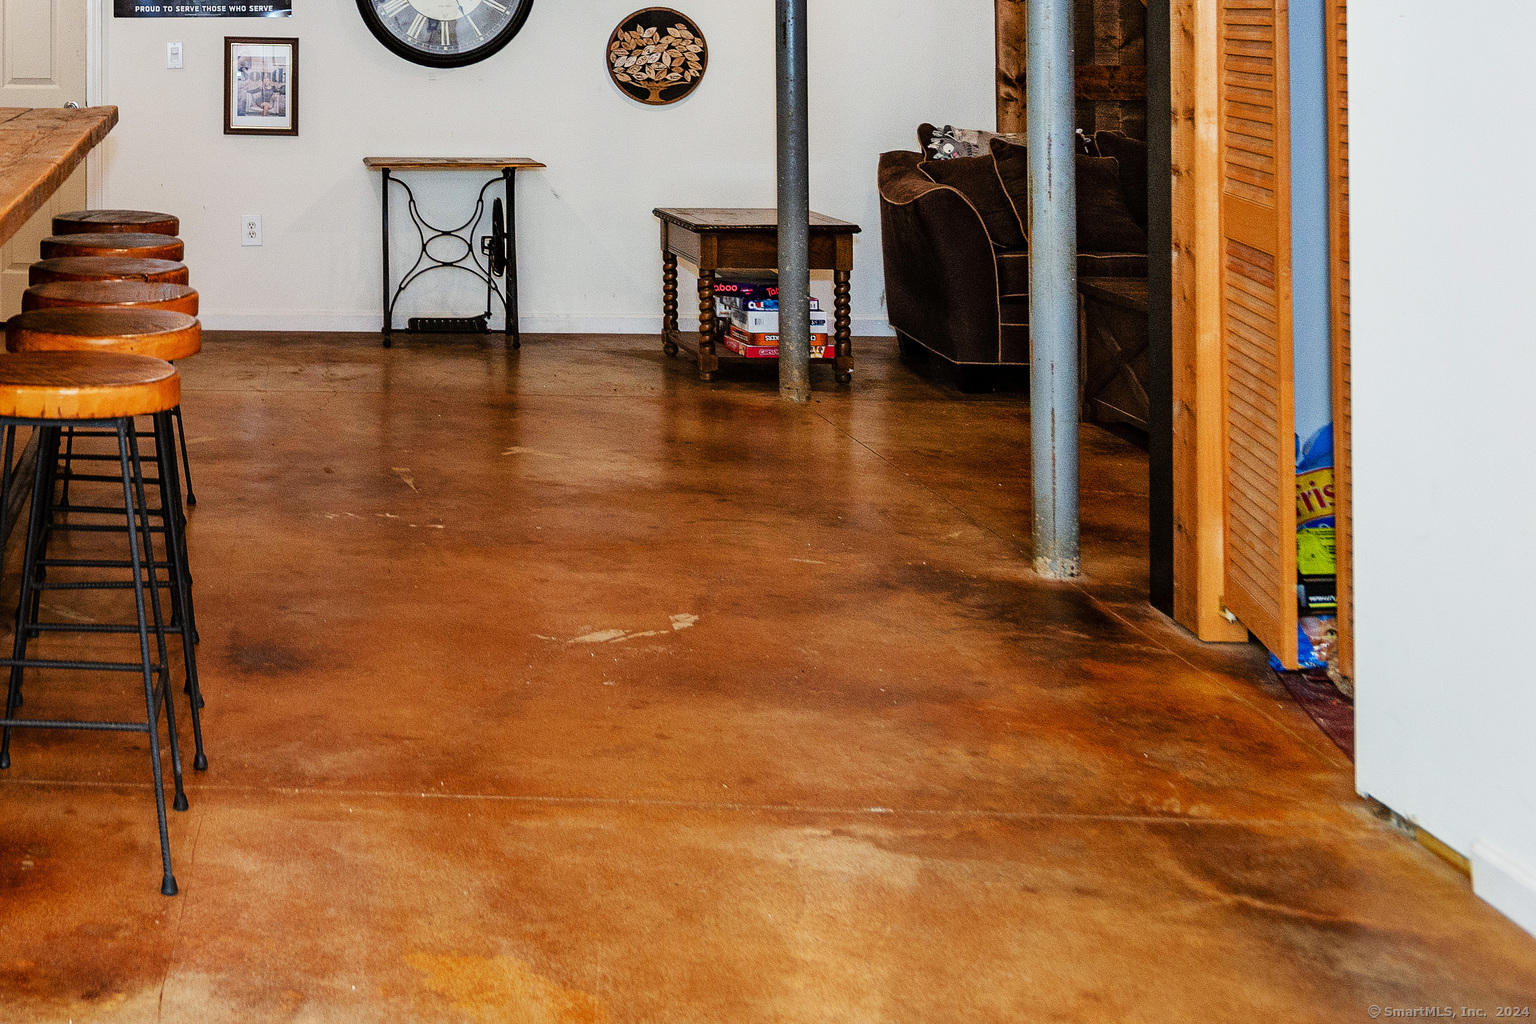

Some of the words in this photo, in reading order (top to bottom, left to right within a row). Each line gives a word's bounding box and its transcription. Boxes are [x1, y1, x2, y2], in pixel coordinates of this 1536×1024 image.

[134, 5, 161, 13] PROUD
[765, 286, 779, 297] Tab
[810, 318, 826, 327] ESHIP
